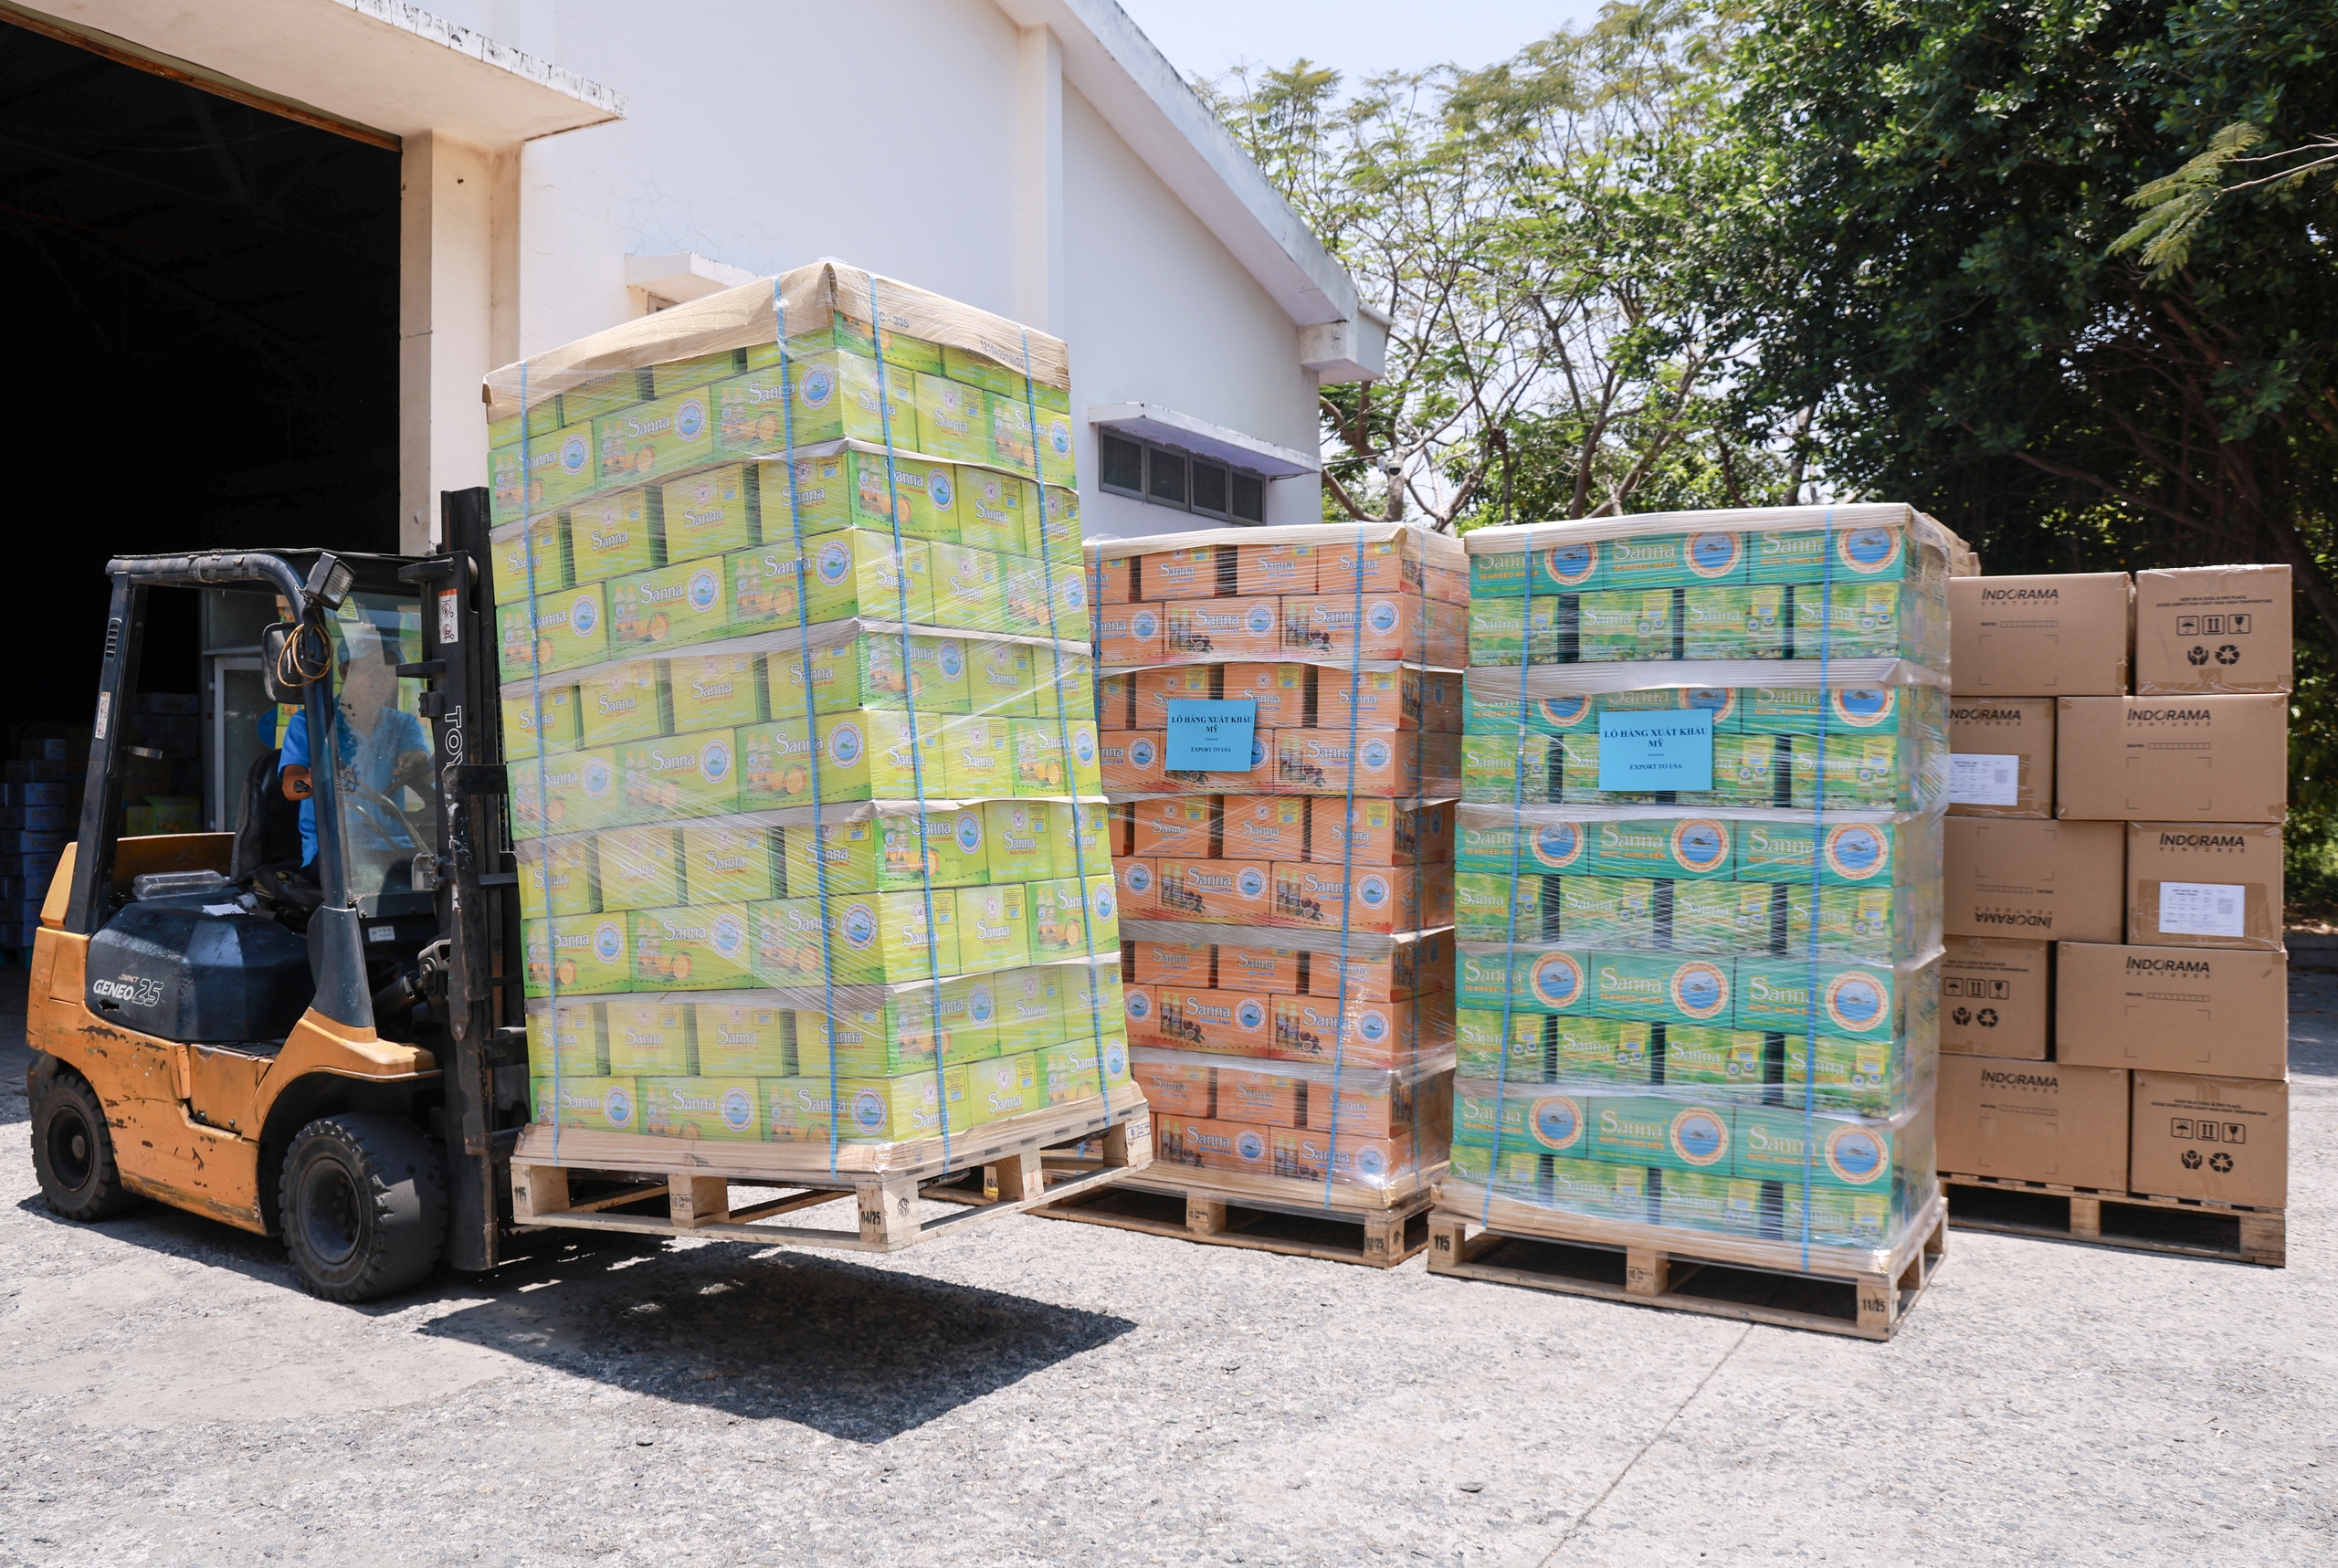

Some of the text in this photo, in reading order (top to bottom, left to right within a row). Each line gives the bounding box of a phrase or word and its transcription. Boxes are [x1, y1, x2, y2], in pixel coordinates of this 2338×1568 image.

[893, 316, 909, 329] 335
[628, 415, 670, 437] Sanna
[935, 408, 968, 434] Sanna
[905, 486, 925, 495] Lemonade
[685, 508, 723, 529] Sanna
[975, 500, 1008, 522] Sanna
[592, 531, 629, 550] Sanna
[1614, 538, 1677, 560] Sanna
[1160, 563, 1195, 577] Sanna
[1257, 556, 1295, 571] Sanna
[1479, 571, 1512, 580] SEAWEED
[640, 583, 683, 605] Sanna
[950, 576, 983, 599] Sanna
[1982, 588, 2059, 600] INDORAMA
[1195, 608, 1240, 626] Sanna
[1474, 614, 1519, 630] Sanna
[1585, 608, 1631, 625] Sanna
[1690, 604, 1741, 622] Sanna
[985, 665, 1017, 685] Sanna
[692, 679, 732, 699] Sanna
[598, 695, 637, 714] Sanna
[1172, 715, 1252, 724] LÔ HÀNG XUẤT KHẨU
[1950, 710, 2021, 720] NDORAMA
[2127, 709, 2211, 721] INDORAMA
[1206, 724, 1218, 733] MỸ
[1604, 726, 1708, 738] LÔ HÀNG XUẤT KHẨU
[1648, 738, 1664, 748] MỸ
[651, 750, 696, 772] Sanna
[961, 748, 995, 768] Sanna
[1467, 751, 1511, 767] Sanna
[1152, 819, 1186, 834] Sanna
[1243, 820, 1280, 836] Sanna
[1004, 831, 1036, 850] Sanna
[1602, 825, 1664, 847] Sanna
[2160, 832, 2245, 847] INDORAMA
[706, 852, 746, 870] Sanna
[1775, 857, 1798, 865] RONG
[1187, 868, 1232, 886] Sanna
[1459, 888, 1504, 905] Sanna
[1975, 912, 2052, 929] INDORAMA
[664, 920, 707, 941] Sanna
[976, 920, 1010, 940] Sanna
[1152, 947, 1187, 963] Sanna
[1238, 953, 1275, 969] Sanna
[2126, 956, 2210, 973] INDORAMA
[1600, 967, 1664, 993] Sanna
[2126, 971, 2210, 979] VENTURES
[93, 978, 164, 1007] GENEO 25
[1600, 994, 1637, 1003] SEAWEED
[1016, 1000, 1048, 1019] Sanna
[1185, 997, 1231, 1016] Sanna
[626, 1026, 664, 1045] Sanna
[717, 1025, 757, 1045] Sanna
[1563, 1033, 1610, 1052] Sanna
[1671, 1041, 1721, 1062] Sanna
[1152, 1075, 1186, 1091] Sanna
[1981, 1068, 2059, 1088] INDORAMA
[561, 1089, 600, 1109] Sanna
[672, 1089, 717, 1111] Sanna
[1237, 1083, 1273, 1100] Sanna
[988, 1093, 1022, 1113] Sanna
[1600, 1110, 1663, 1138] Sanna
[1186, 1126, 1231, 1147] Sanna
[861, 1210, 880, 1226] 04/25
[1434, 1235, 1450, 1251] 115
[1862, 1300, 1885, 1313] 11/25
